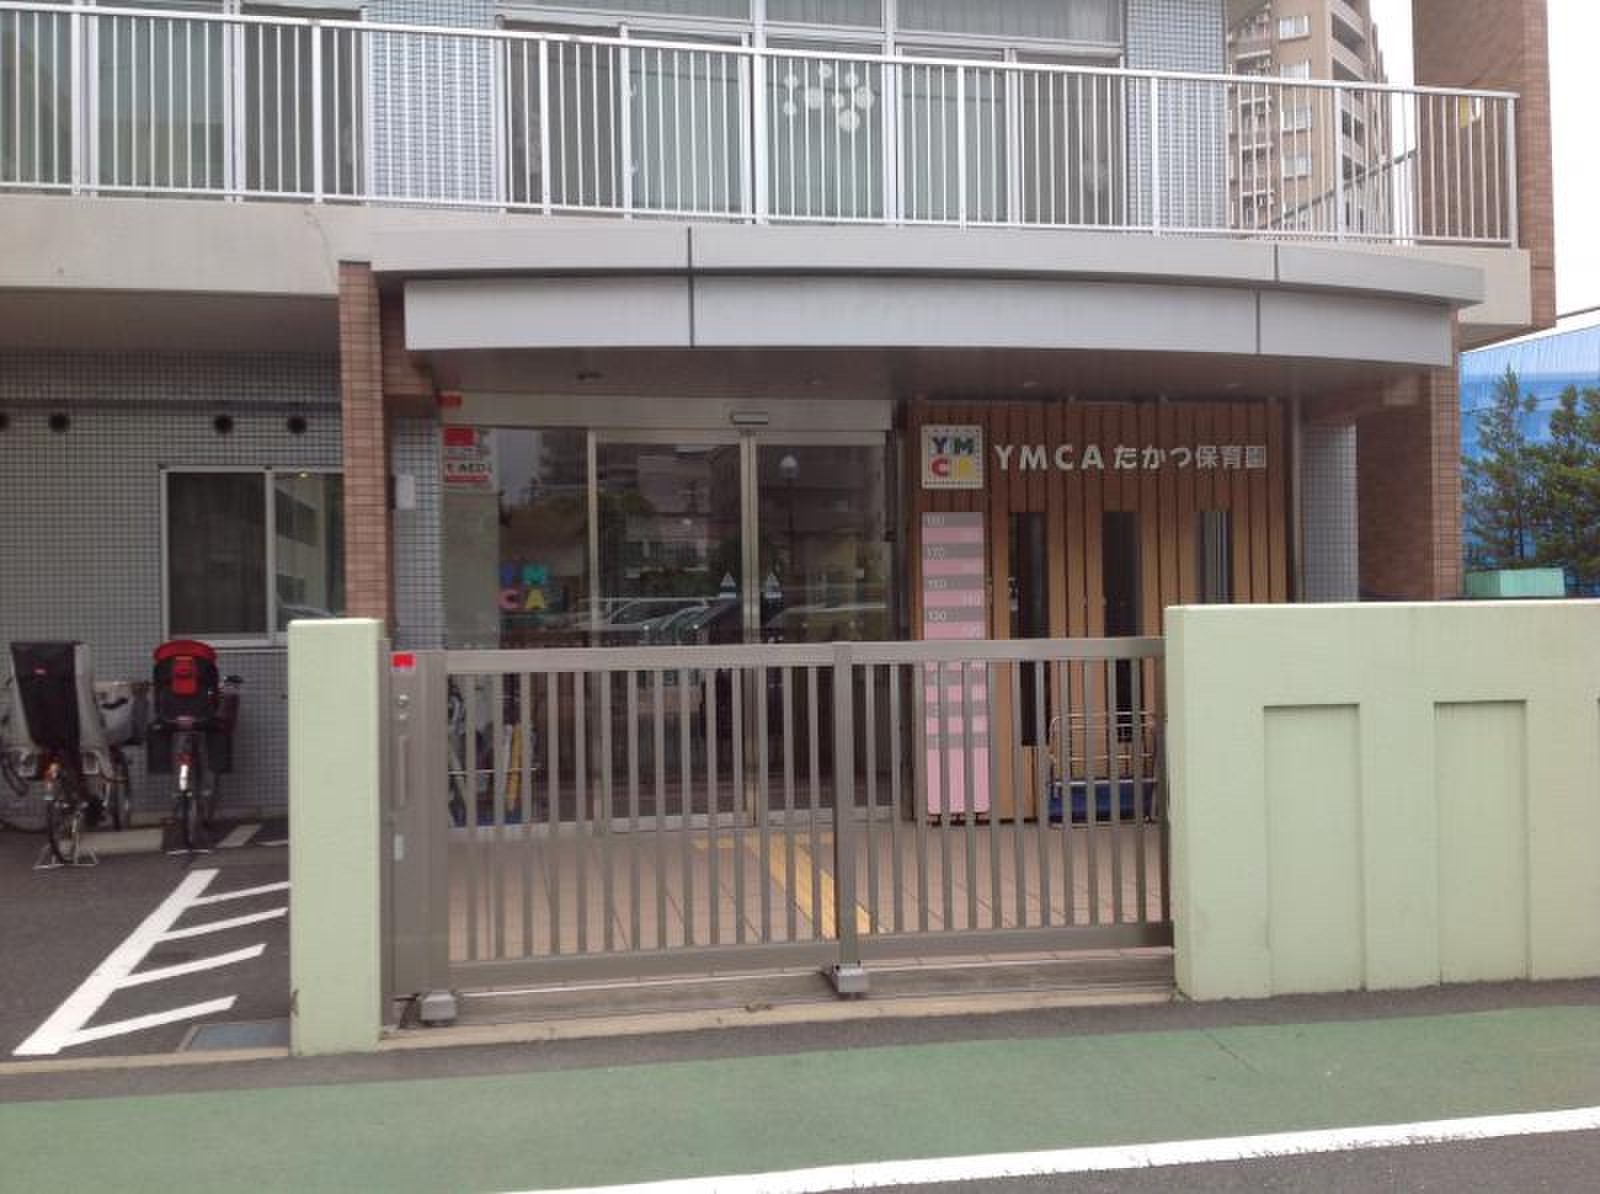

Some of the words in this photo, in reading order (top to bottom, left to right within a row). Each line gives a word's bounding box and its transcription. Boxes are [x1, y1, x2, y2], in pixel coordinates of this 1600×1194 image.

[994, 444, 1105, 471] YMCA
[1113, 444, 1267, 470] たかつ保育園
